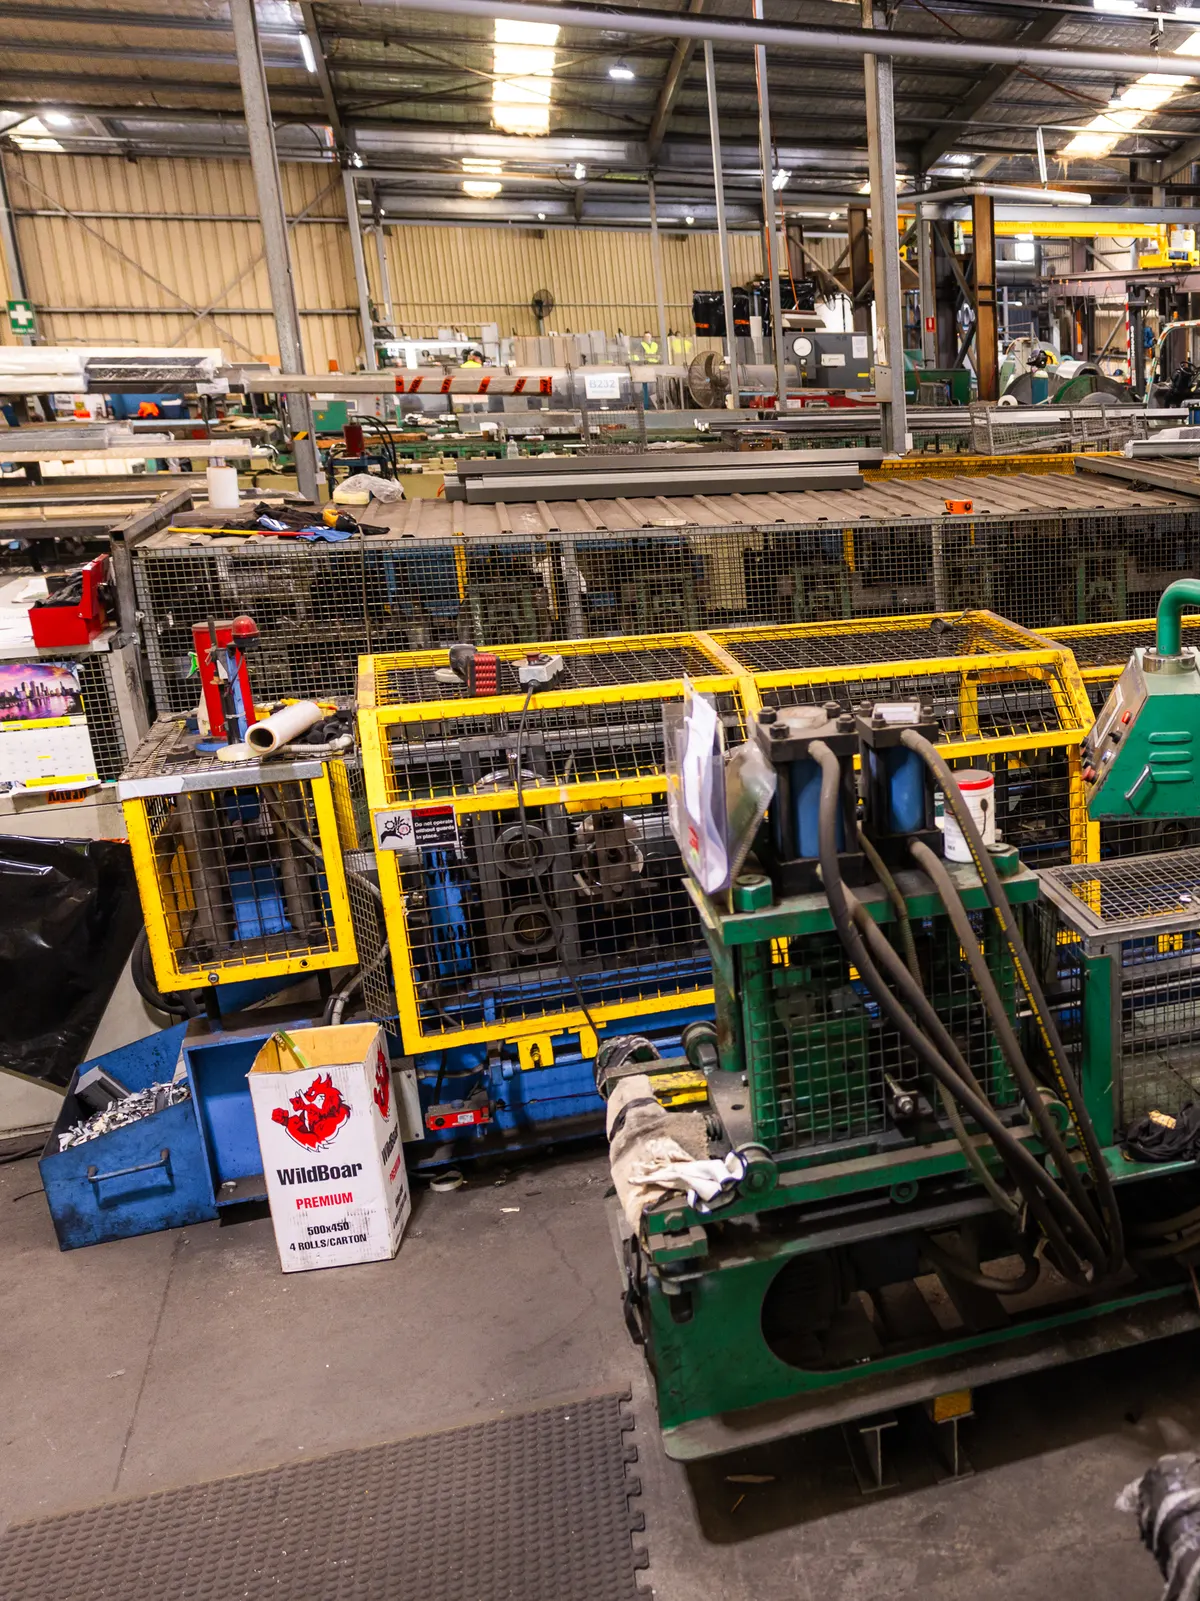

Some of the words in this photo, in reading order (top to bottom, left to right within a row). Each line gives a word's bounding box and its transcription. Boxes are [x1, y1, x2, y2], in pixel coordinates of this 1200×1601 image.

[277, 1162, 363, 1186] WildBoar
[296, 1192, 353, 1210] PREMIUM
[307, 1220, 350, 1236] 500x450
[289, 1243, 296, 1251] 4
[298, 1234, 367, 1251] ROLLS/CARTON
